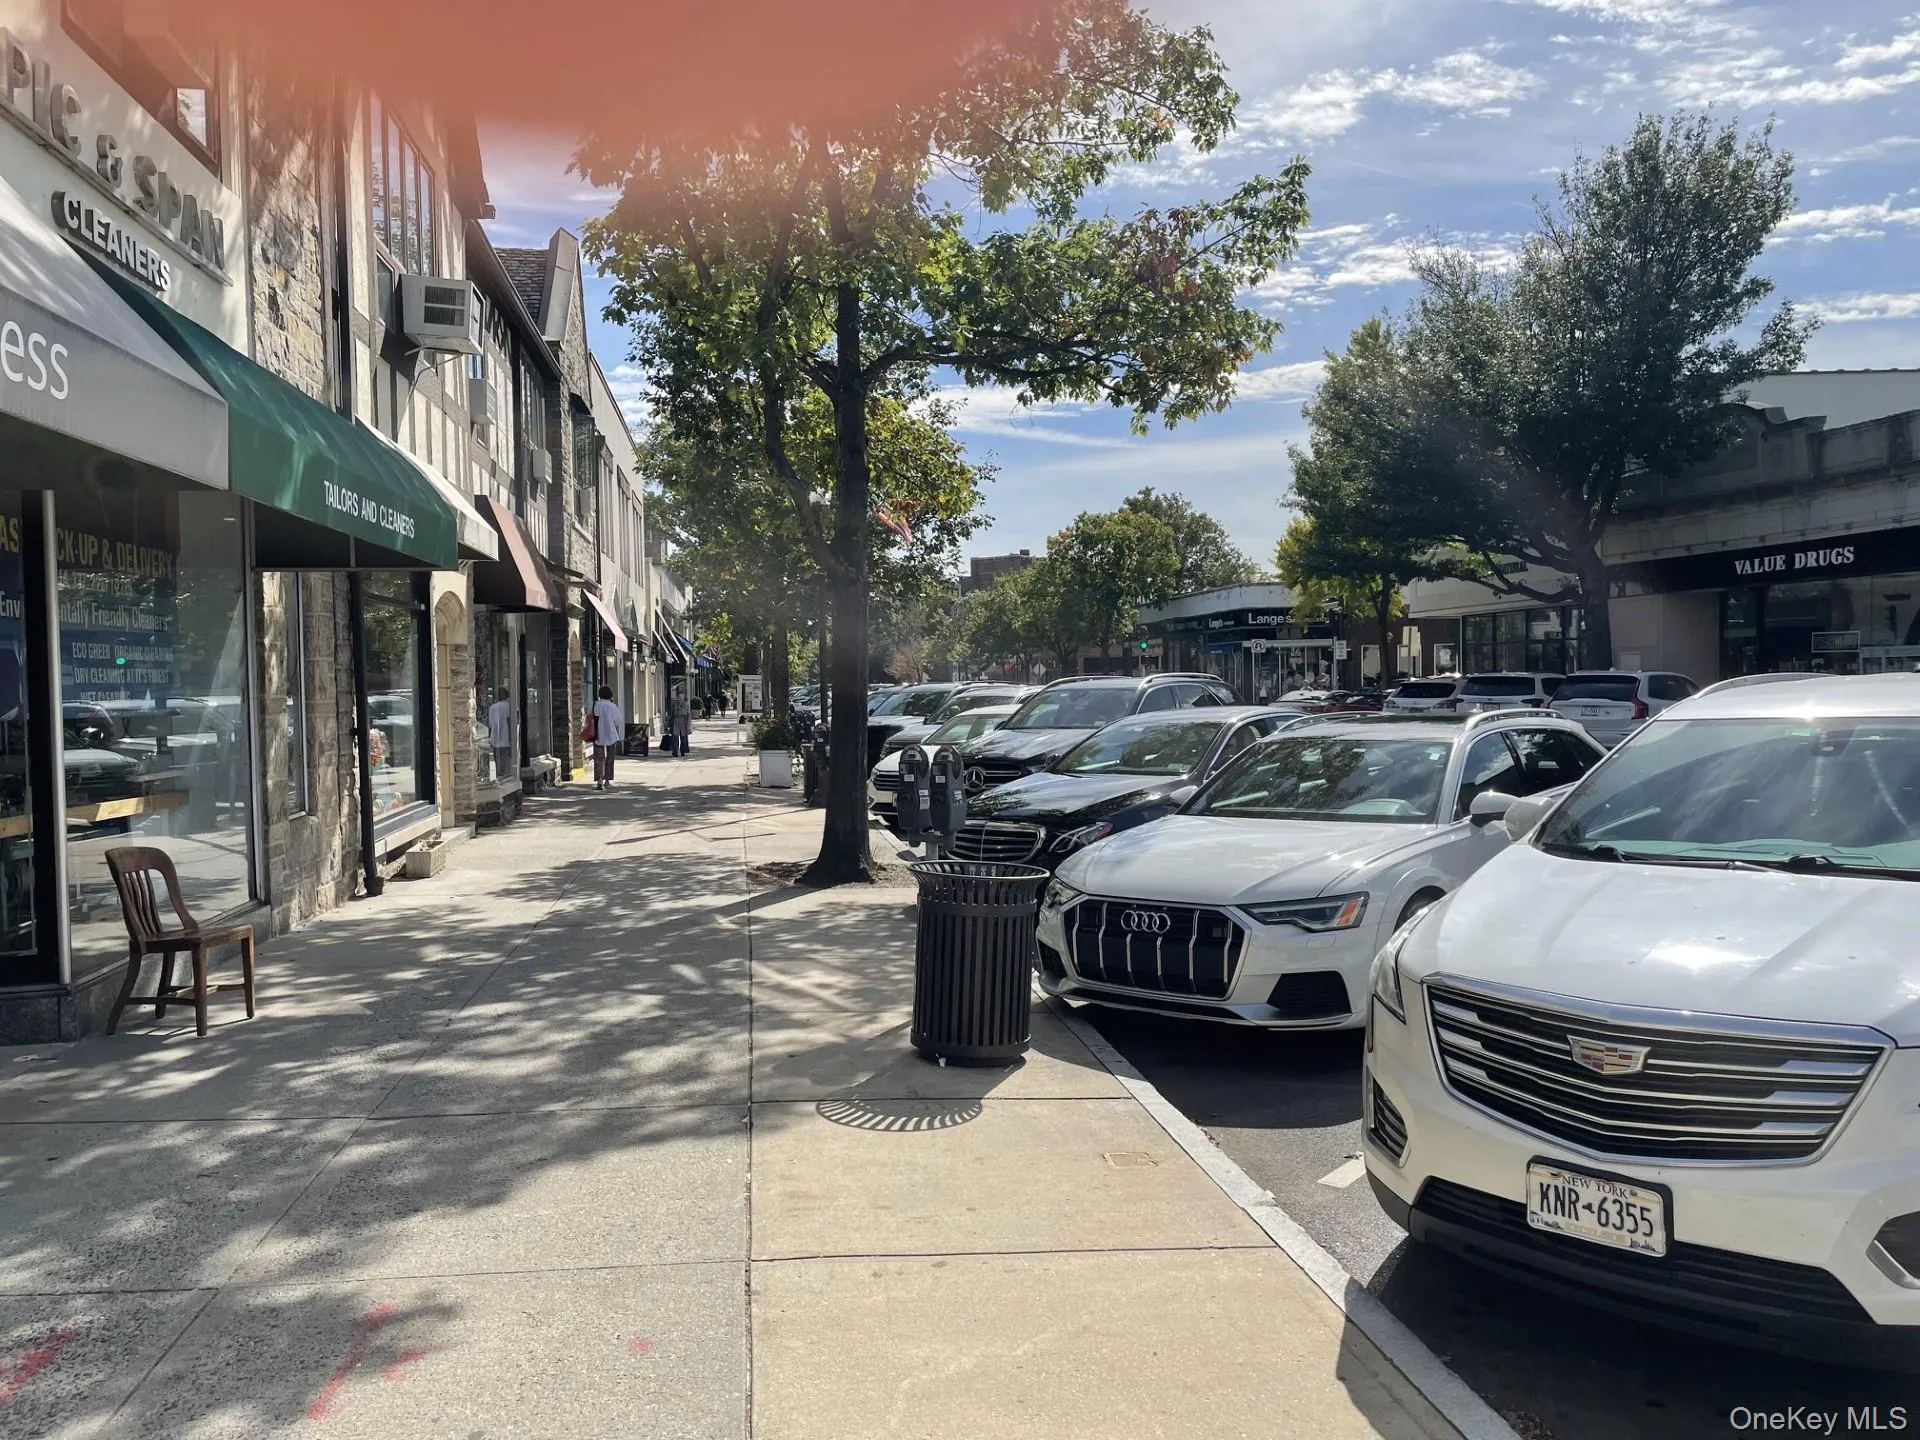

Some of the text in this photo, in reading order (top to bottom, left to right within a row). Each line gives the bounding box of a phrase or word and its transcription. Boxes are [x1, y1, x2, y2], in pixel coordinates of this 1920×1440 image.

[97, 134, 123, 189] &
[132, 155, 225, 270] SPAN
[52, 190, 171, 292] CLEANERS
[1, 320, 68, 400] ess
[324, 480, 415, 539] TAILORS AND CLEANERS
[102, 539, 113, 570] &
[117, 541, 172, 579] DELIVERY
[1734, 547, 1854, 575] VALUE DRUGS
[92, 603, 130, 632] Friendly
[132, 607, 168, 631] Cleaners
[72, 642, 87, 658] ECO
[74, 667, 89, 683] DRY
[1562, 1175, 1628, 1199] NEW YORK
